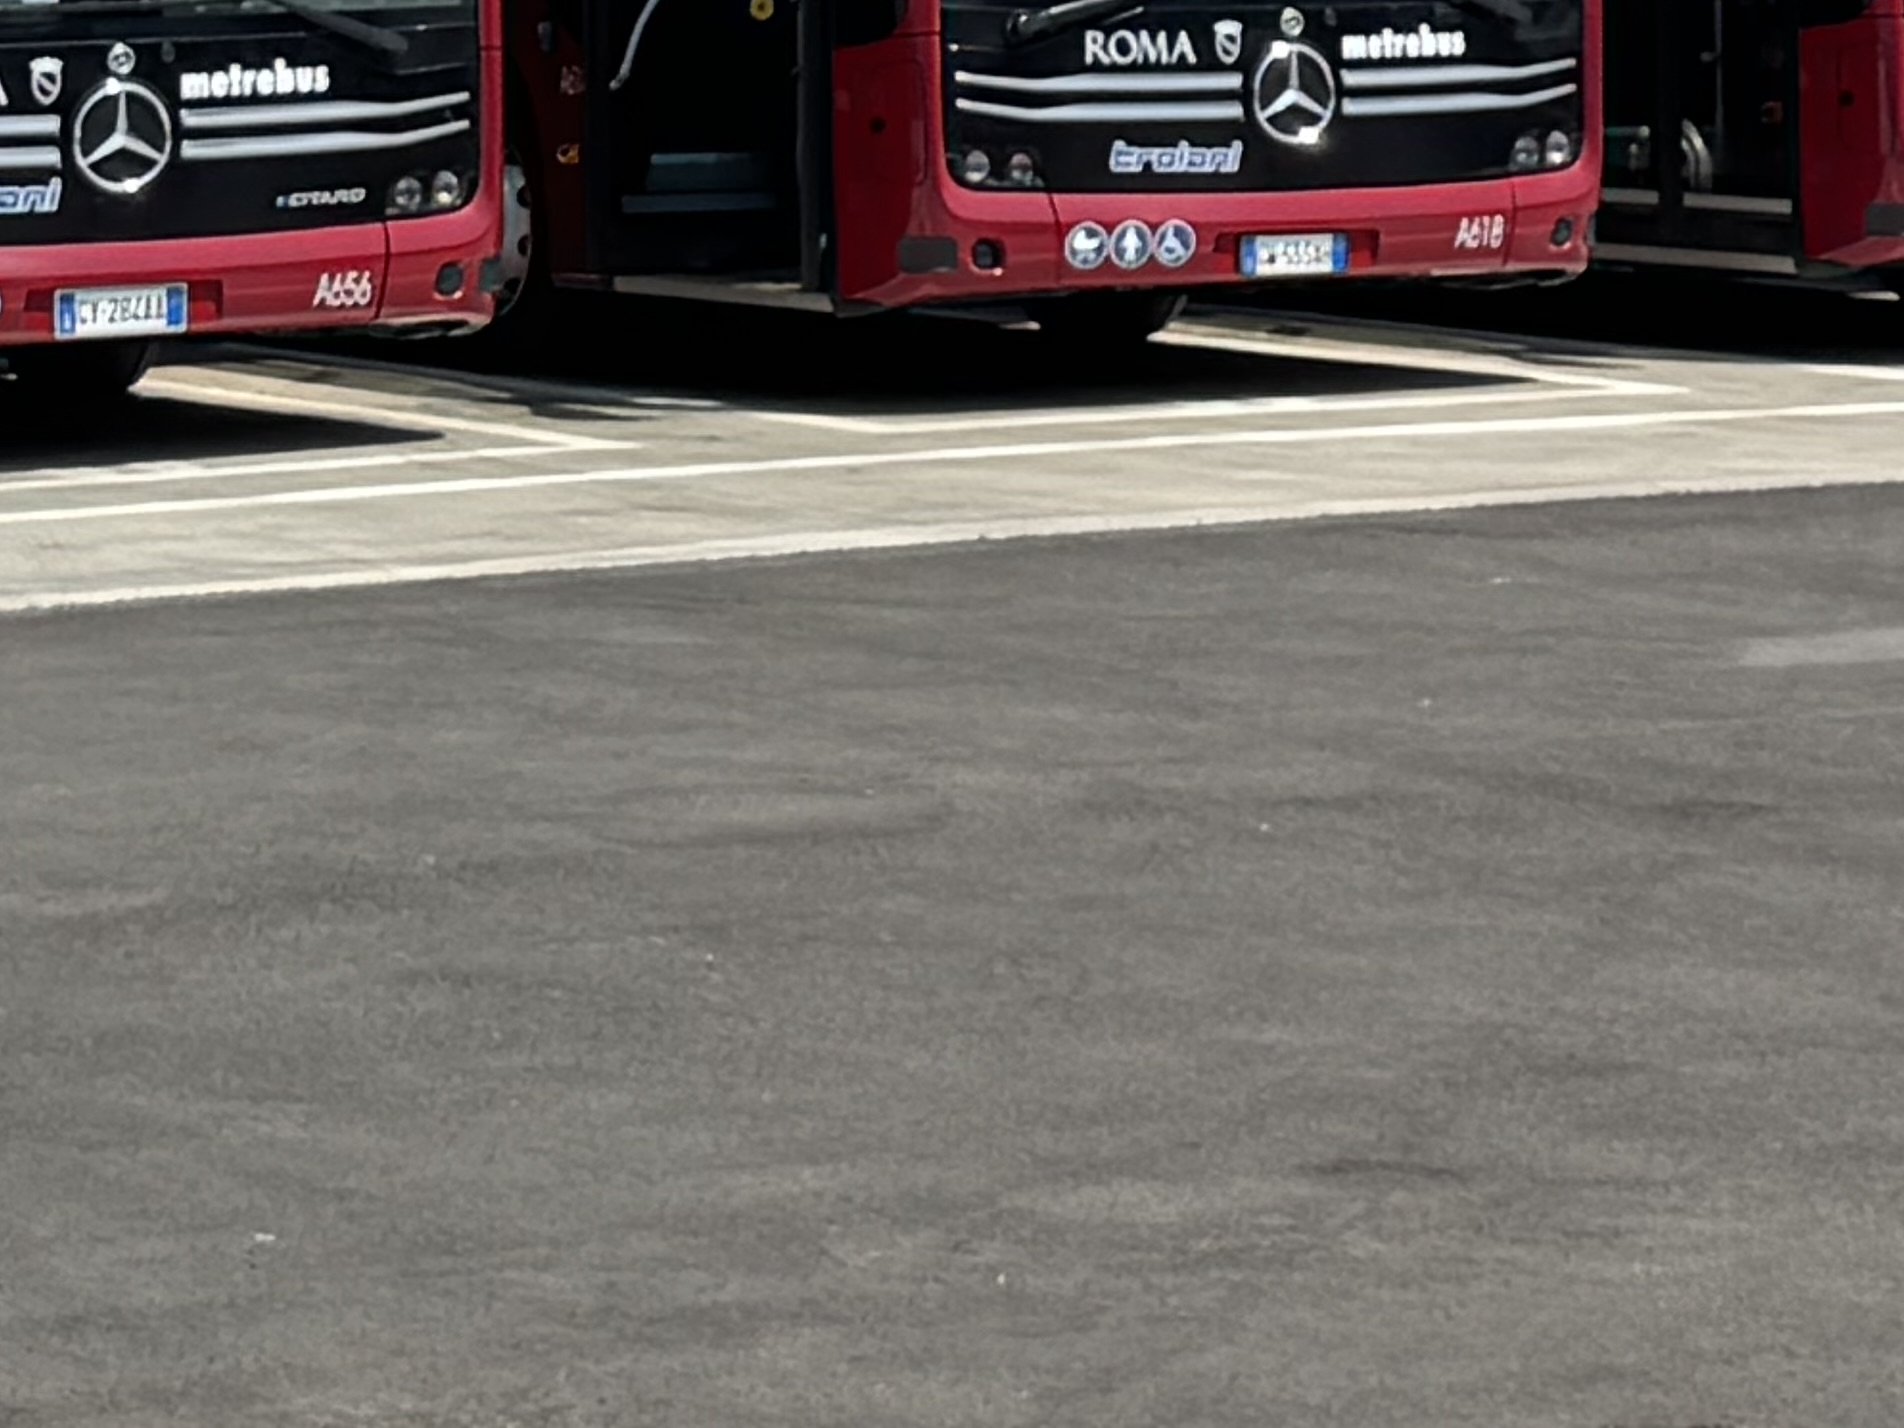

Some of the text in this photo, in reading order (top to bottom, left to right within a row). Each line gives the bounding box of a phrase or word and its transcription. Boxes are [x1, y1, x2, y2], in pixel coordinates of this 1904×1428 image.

[1084, 28, 1197, 66] ROMA
[1341, 22, 1466, 60] metrobus
[181, 58, 330, 99] metrobus
[1109, 139, 1243, 174] troiani
[1454, 214, 1505, 249] A618
[313, 271, 372, 308] A656
